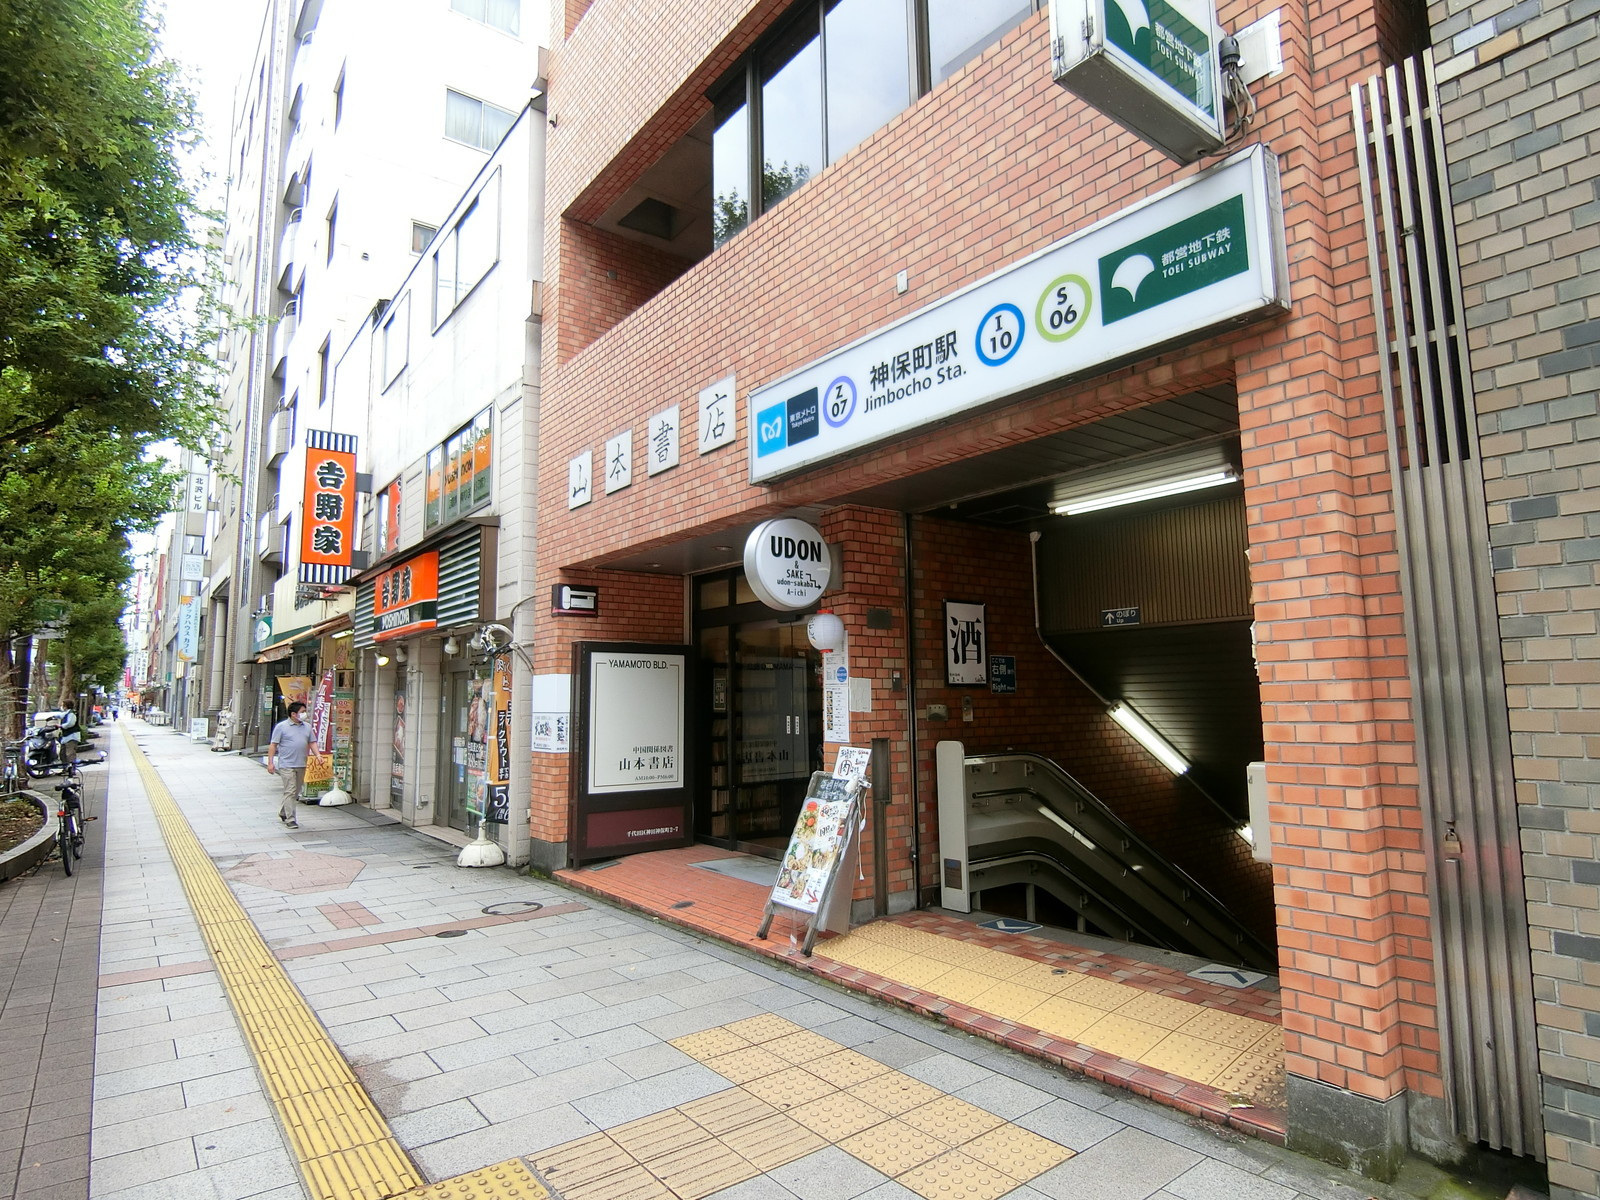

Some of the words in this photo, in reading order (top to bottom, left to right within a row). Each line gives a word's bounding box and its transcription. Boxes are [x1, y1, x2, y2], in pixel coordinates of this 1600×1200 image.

[1155, 39, 1173, 61] TOEI
[1162, 226, 1232, 268] 都営地下鉄
[1162, 260, 1186, 279] TOEI
[1188, 243, 1233, 269] SUBWAY
[1056, 286, 1068, 306] S
[994, 315, 1003, 333] I
[1049, 307, 1078, 332] 06
[989, 332, 1013, 355] 10
[868, 330, 959, 392] 神保町駅
[835, 384, 844, 400] Z
[862, 376, 933, 414] Jimbocho
[937, 364, 967, 391] Sta.
[789, 405, 817, 423] 東京メトロ
[831, 401, 849, 417] 07
[791, 419, 803, 430] Tokyo
[803, 415, 816, 426] Metro
[571, 391, 729, 499] 山本書店
[193, 477, 205, 511] 北沢ビル
[313, 461, 346, 556] 吉野家
[770, 535, 822, 562] UDON
[786, 569, 804, 580] SAKE
[794, 560, 800, 569] &
[382, 566, 413, 609] 吉野家
[776, 578, 814, 588] udon-sakaba
[786, 588, 807, 597] A-ichi
[1115, 609, 1136, 618] のぼり
[950, 616, 982, 665] 酒
[608, 658, 653, 670] YAMAMOTO
[653, 659, 669, 670] BLD.
[992, 683, 1006, 692] Right
[498, 712, 508, 767] テイクアウト
[632, 745, 674, 755] 中国関係図書
[618, 755, 674, 771] 山本書店
